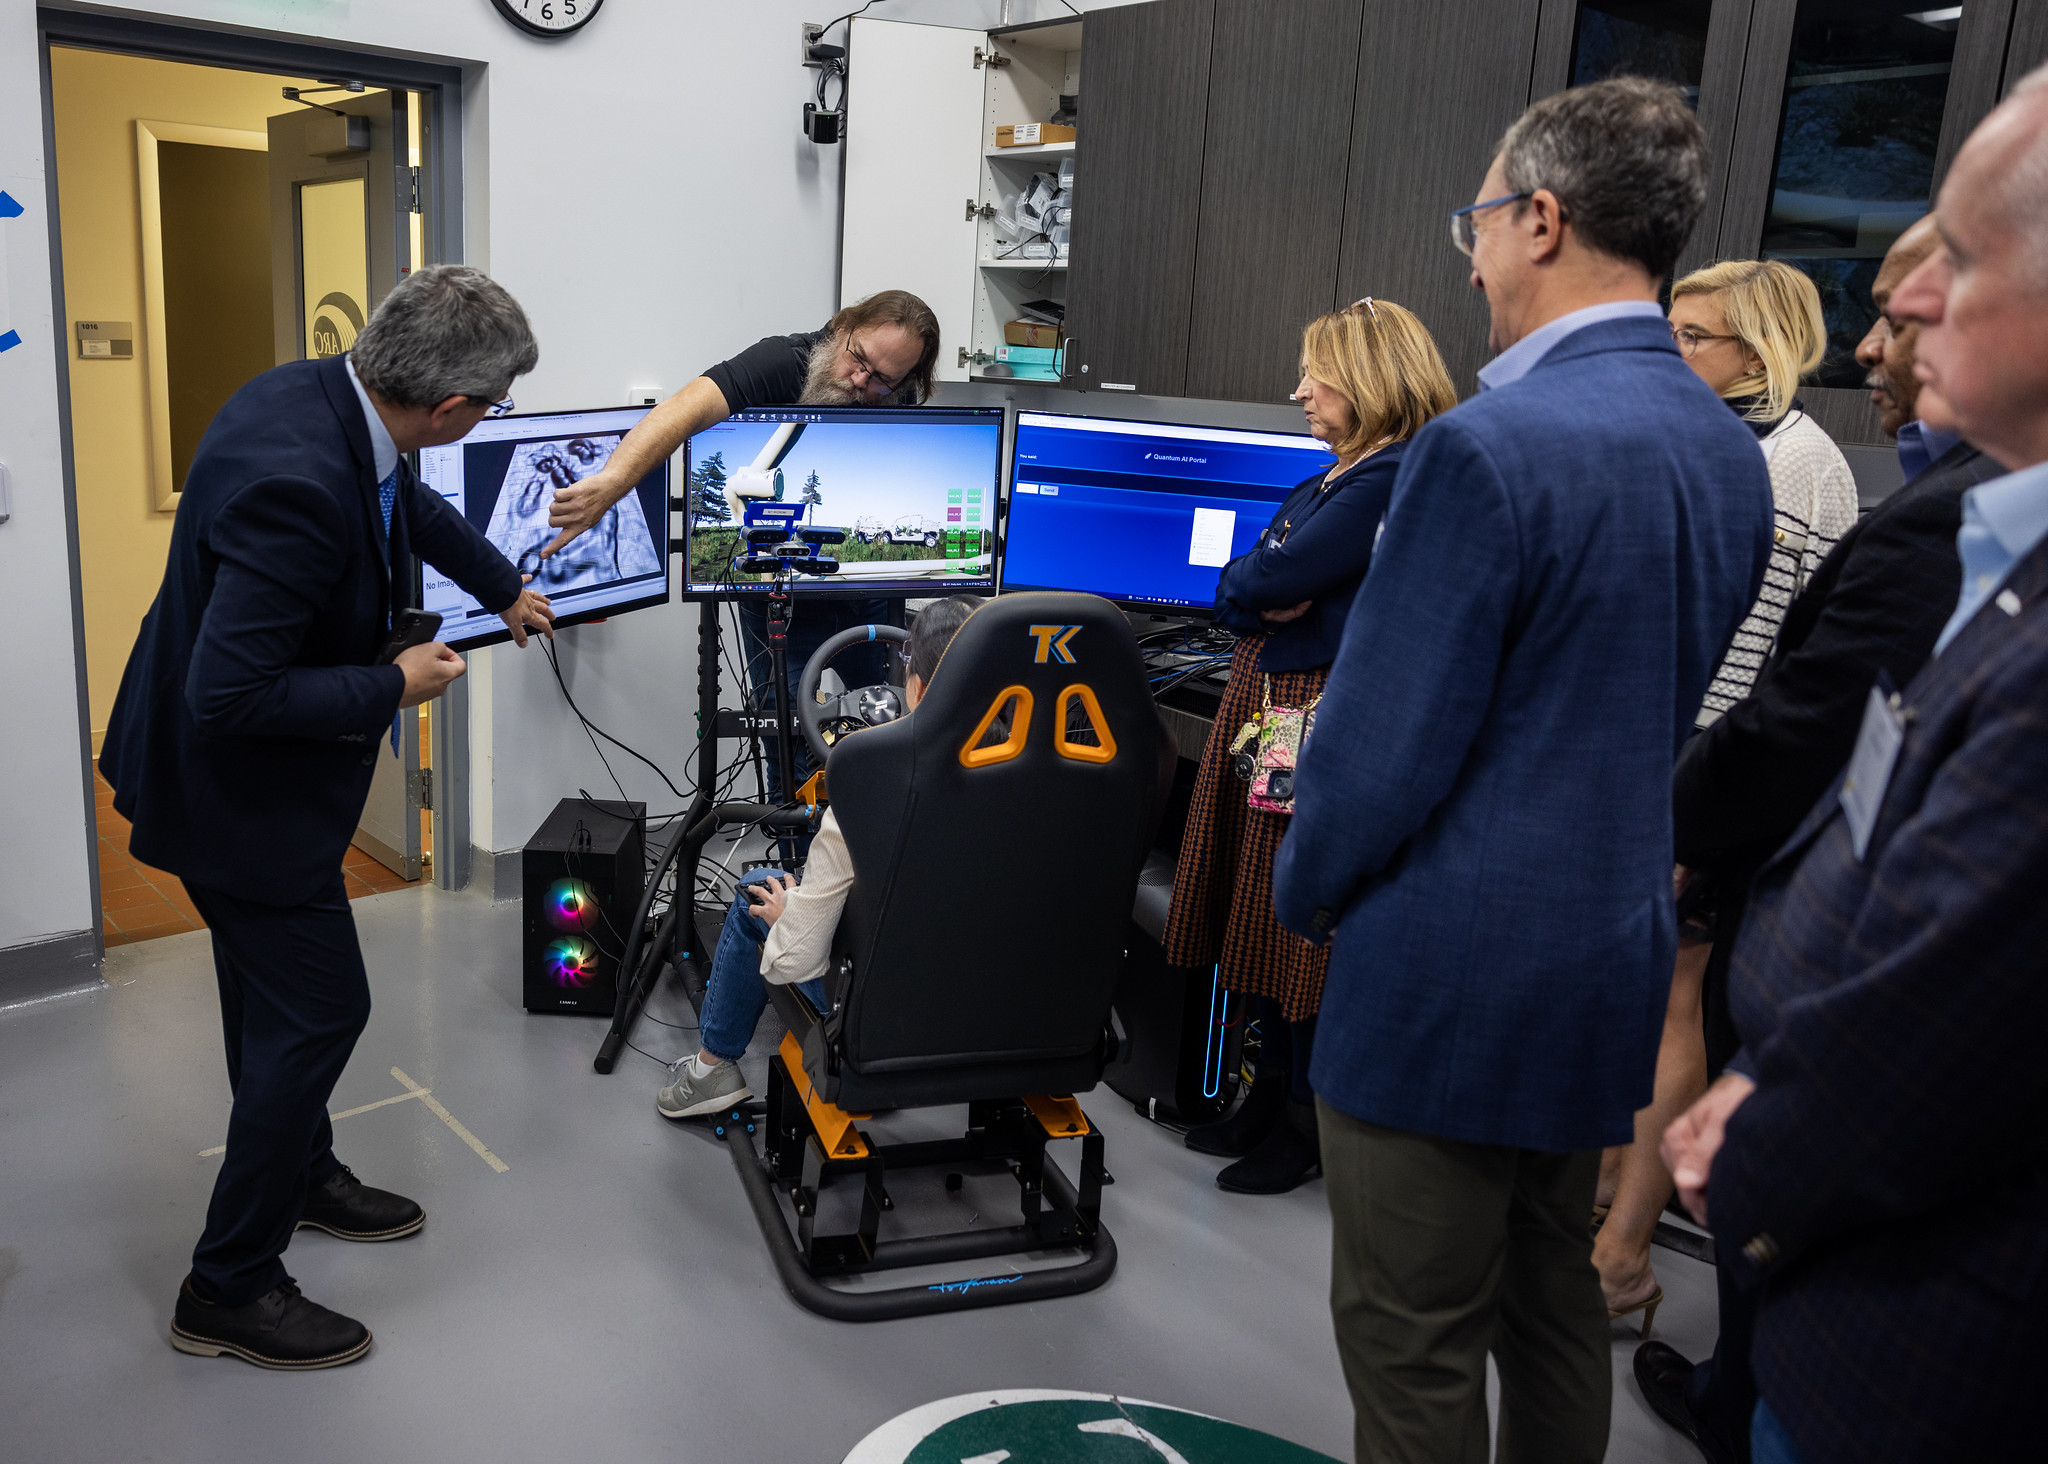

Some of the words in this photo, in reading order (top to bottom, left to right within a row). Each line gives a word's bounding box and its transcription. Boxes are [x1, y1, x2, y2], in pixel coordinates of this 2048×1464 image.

[542, 3, 553, 20] 6
[565, 0, 576, 15] 5
[1153, 453, 1180, 461] Quantum
[426, 582, 435, 590] No
[437, 580, 455, 588] Imag
[1028, 624, 1083, 664] TK
